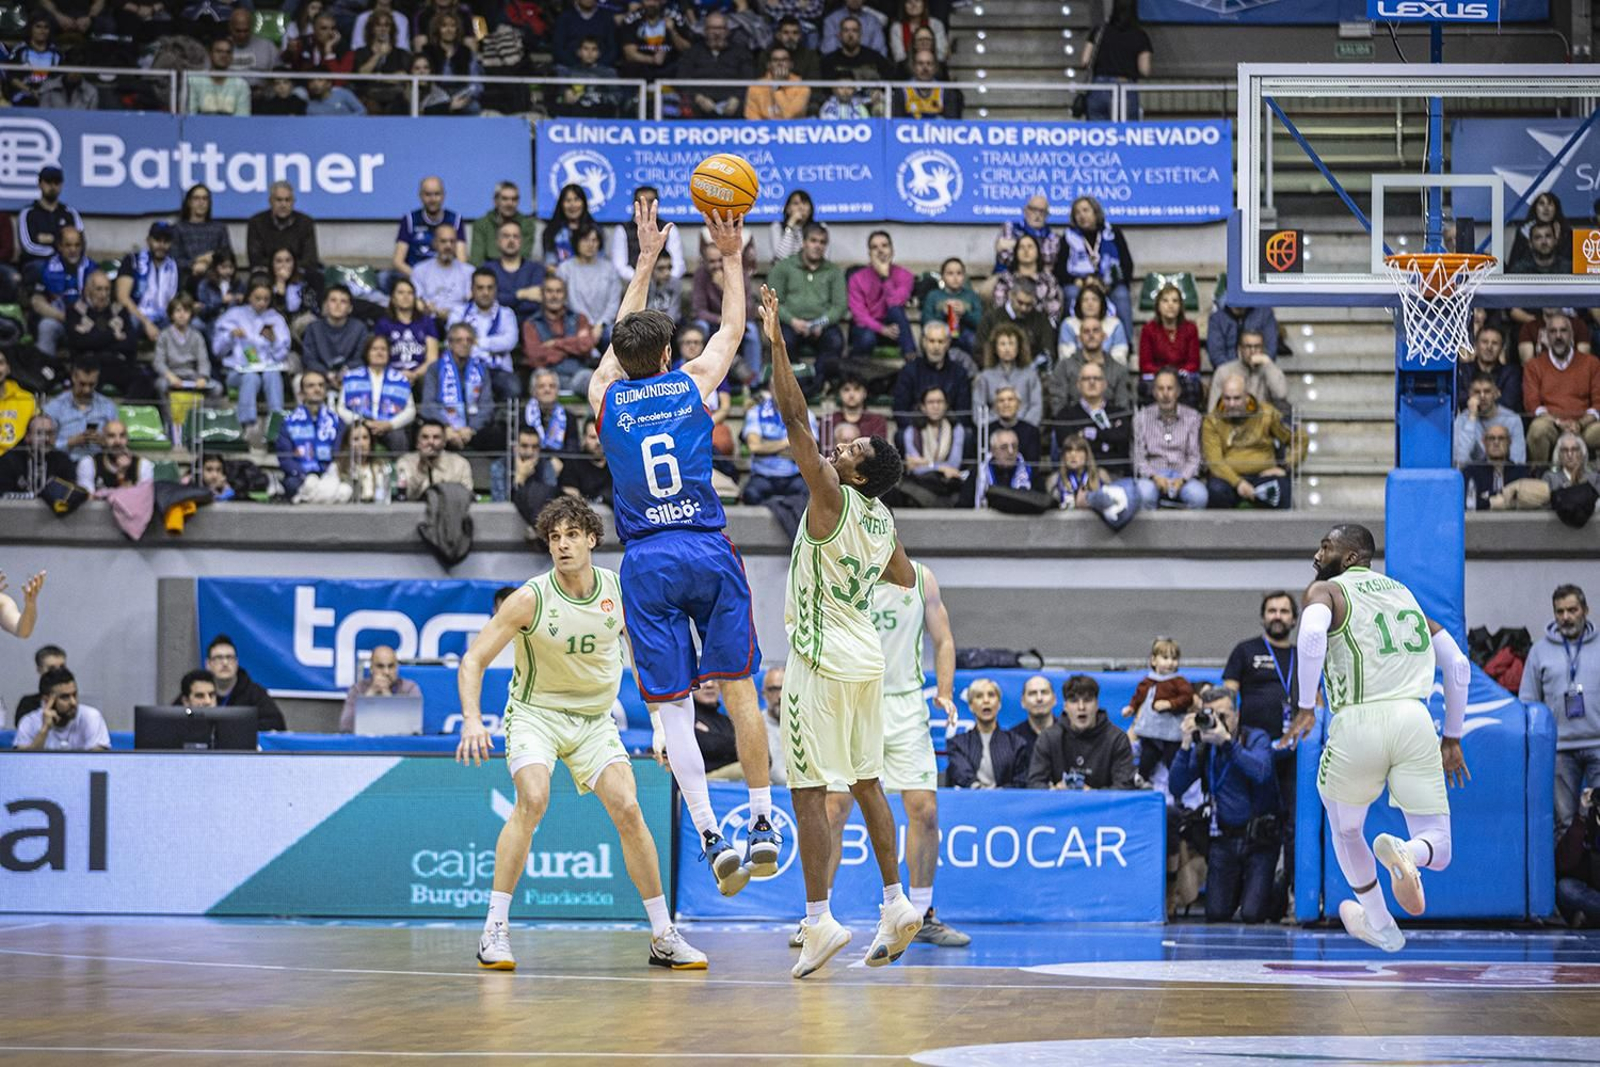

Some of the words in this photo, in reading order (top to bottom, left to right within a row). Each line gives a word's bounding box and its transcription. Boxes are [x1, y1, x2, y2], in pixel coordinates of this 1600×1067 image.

[1377, 1, 1489, 19] LEXUS
[548, 122, 636, 145] CLÍNICA
[640, 126, 671, 145] DE
[674, 124, 872, 146] PROPIOS-NEVADO
[896, 122, 984, 145] CLÍNICA
[987, 127, 1018, 146] DE
[1022, 125, 1220, 147] PROPIOS-NEVADO
[81, 133, 385, 194] Battaner
[981, 149, 1123, 168] TRAUMATOLOGÍA
[797, 163, 873, 182] ESTÉTICA
[980, 167, 1049, 184] CIRUGÍA
[1052, 166, 1129, 184] PLÁSTICA
[1131, 168, 1142, 184] Y
[1145, 165, 1220, 184] ESTÉTICA
[980, 183, 1048, 200] TERAPIA
[1051, 185, 1072, 201] DE
[1077, 184, 1132, 201] MANO
[615, 381, 690, 406] GUDMUNDSSON
[641, 432, 683, 498] 6
[831, 555, 881, 607] 32
[870, 611, 897, 631] 25
[1374, 609, 1430, 655] 13
[565, 634, 596, 655] 16
[841, 825, 1127, 867] BGOCAR
[410, 884, 492, 907] Burgos
[525, 888, 614, 906] Fundación
